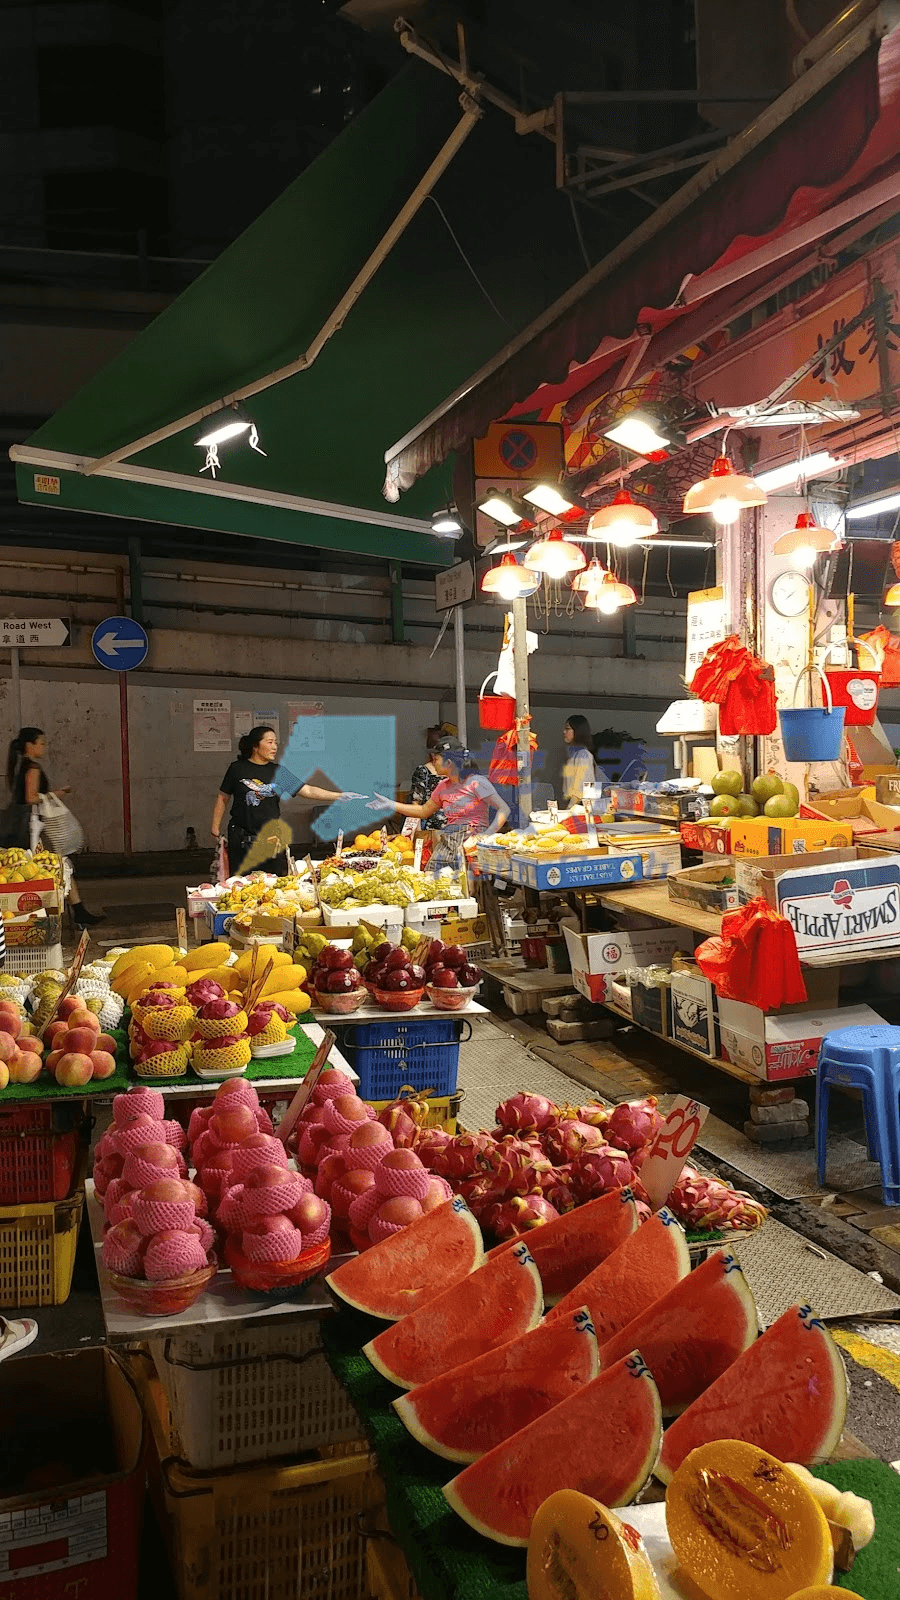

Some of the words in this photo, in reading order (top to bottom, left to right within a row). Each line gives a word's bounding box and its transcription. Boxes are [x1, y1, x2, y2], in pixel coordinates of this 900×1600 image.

[3, 621, 26, 630] Road
[29, 621, 52, 630] West
[1, 634, 40, 644] 拿道西
[888, 780, 900, 793] FR
[565, 864, 593, 874] GRAPES
[593, 862, 616, 871] TABLE
[569, 871, 614, 882] AUSTRALIAN
[843, 888, 897, 936] SMART
[787, 903, 844, 940] APPLE
[606, 946, 618, 960] 福
[620, 1188, 635, 1204] 35
[452, 1198, 470, 1213] 35
[657, 1210, 679, 1227] 35
[513, 1246, 535, 1265] 35
[719, 1255, 743, 1274] 35
[573, 1311, 595, 1335] 35
[798, 1304, 826, 1331] 35
[625, 1355, 654, 1380] 35
[588, 1510, 609, 1541] 20
